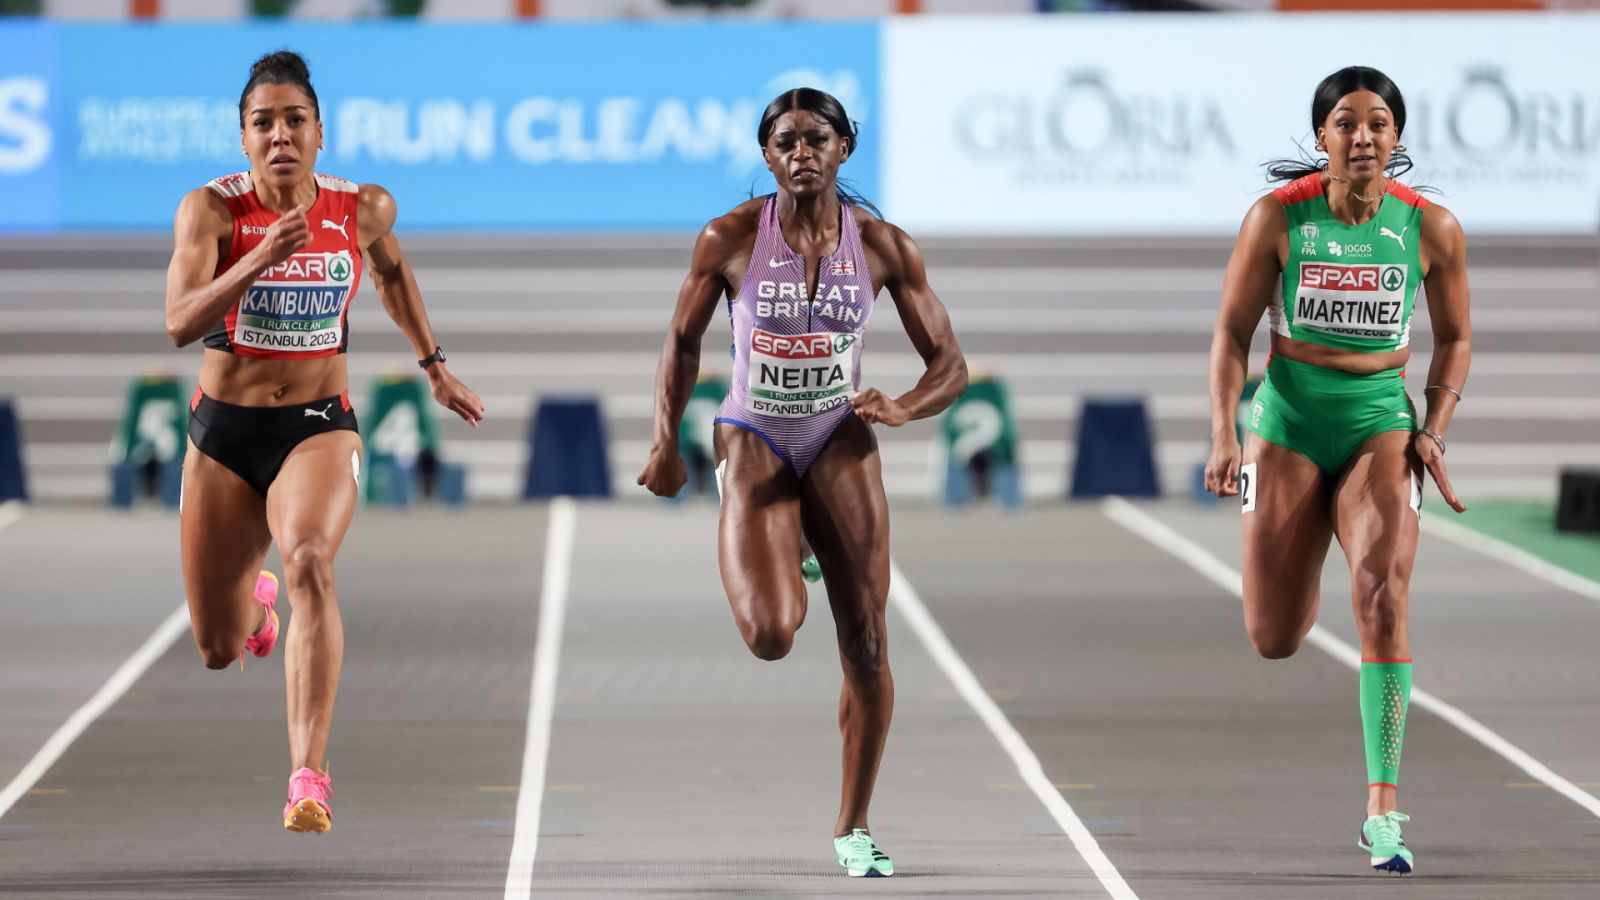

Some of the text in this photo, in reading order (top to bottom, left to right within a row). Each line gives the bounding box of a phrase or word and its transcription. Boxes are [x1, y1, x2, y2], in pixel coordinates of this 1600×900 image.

[337, 97, 496, 163] RUN
[252, 226, 271, 235] UB
[1344, 244, 1372, 255] JOGOS
[1304, 268, 1377, 288] SPAR
[757, 280, 860, 303] GREAT
[244, 290, 348, 315] KAMBUNDJI
[756, 300, 863, 323] BRITAIN
[1297, 296, 1402, 325] MARTINEZ
[267, 320, 290, 331] RUN
[291, 321, 322, 331] CLEAN
[242, 329, 338, 347] ISTANBUL 2023
[754, 336, 829, 356] SPAR
[760, 363, 845, 389] NEITA
[753, 400, 817, 415] ISTANBUL
[1241, 472, 1250, 506] 2
